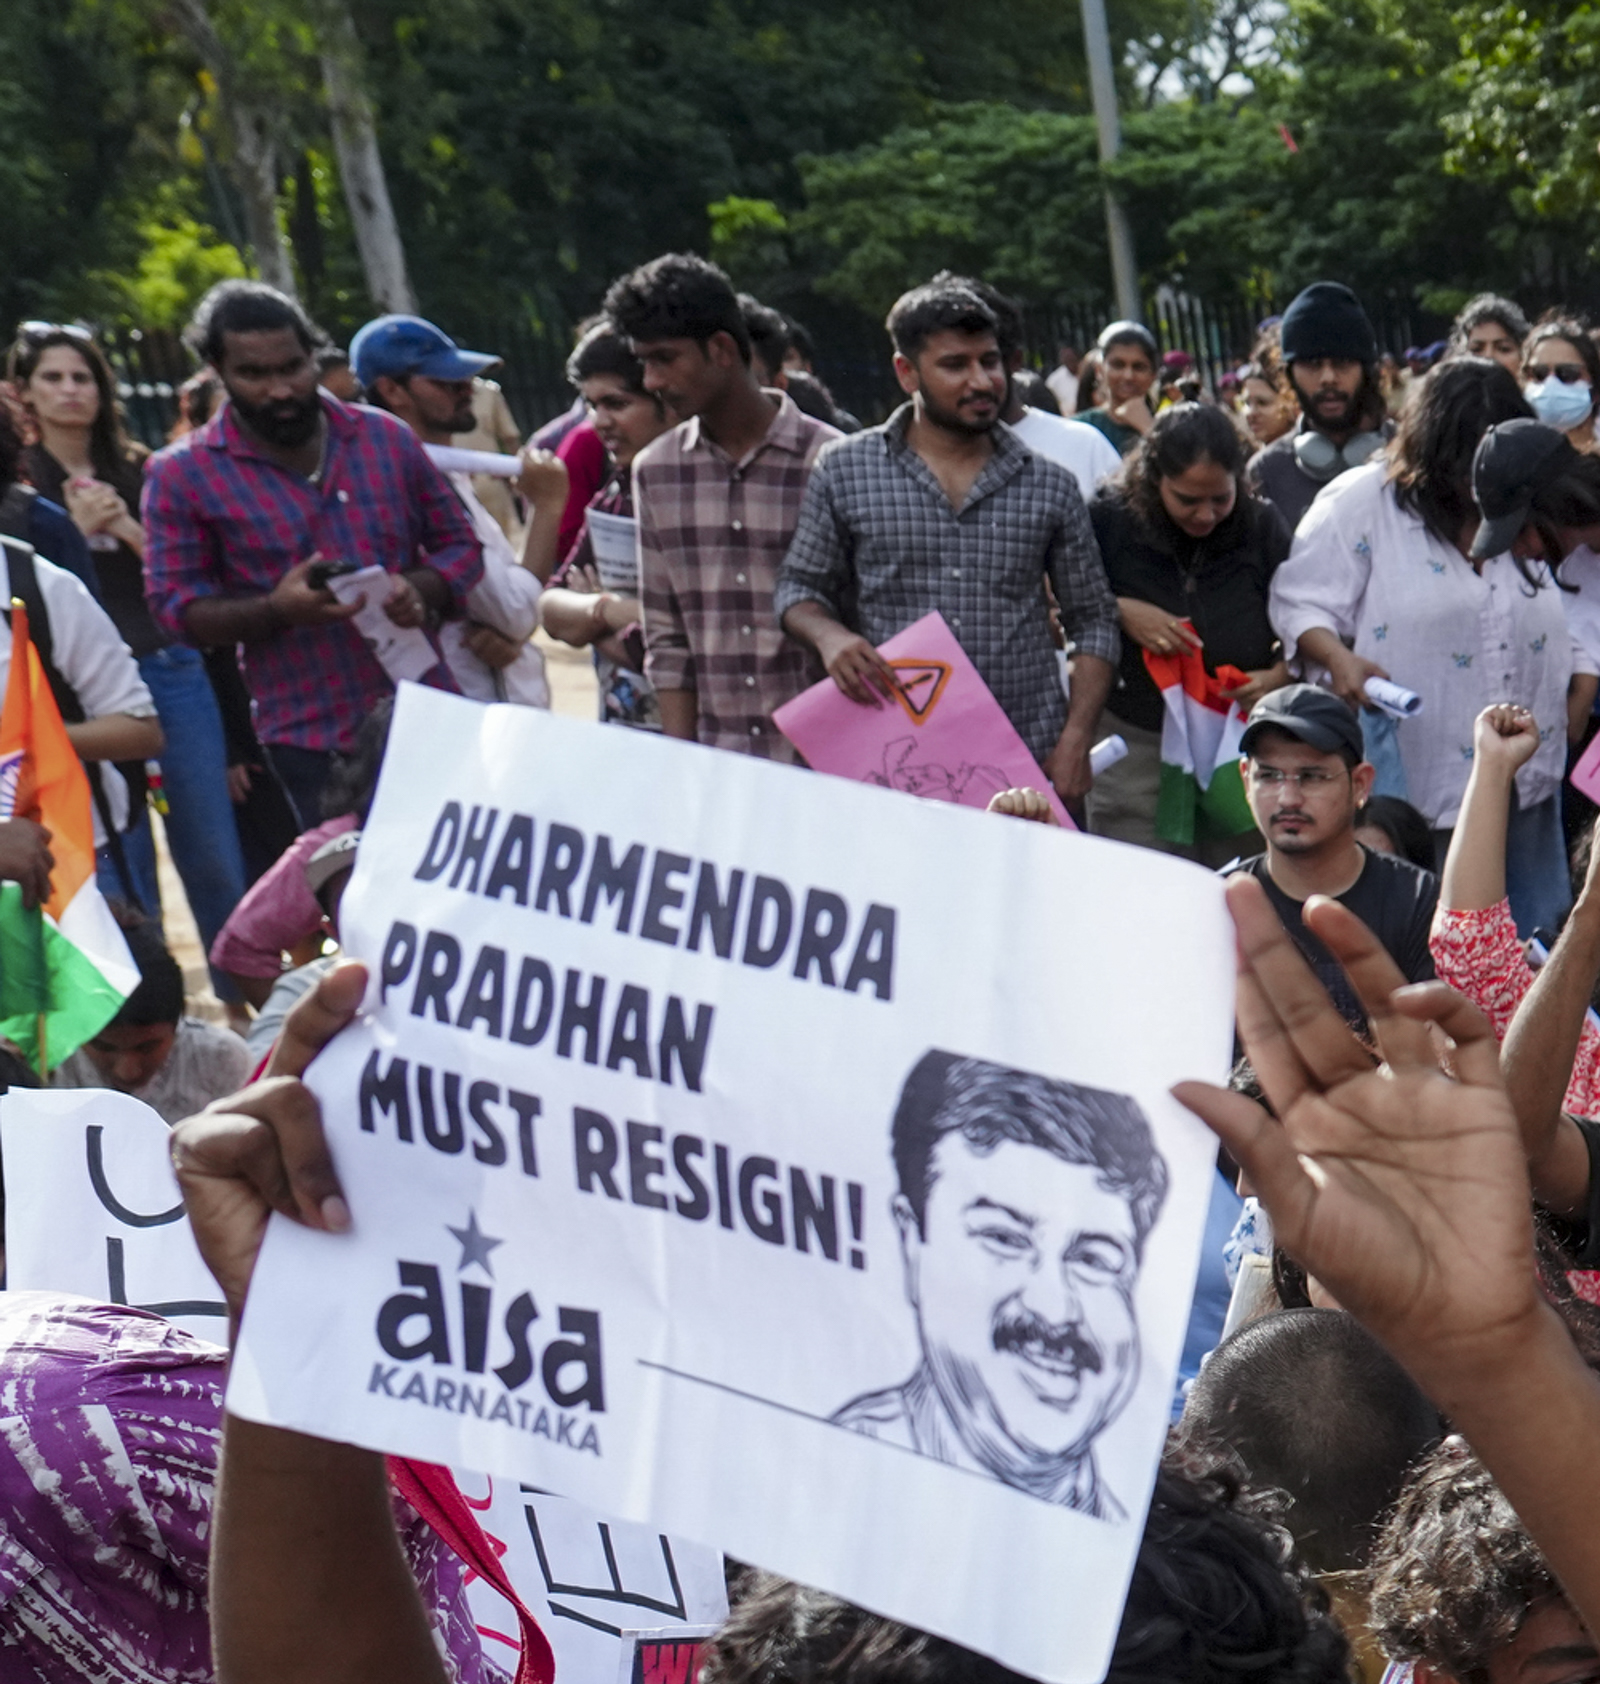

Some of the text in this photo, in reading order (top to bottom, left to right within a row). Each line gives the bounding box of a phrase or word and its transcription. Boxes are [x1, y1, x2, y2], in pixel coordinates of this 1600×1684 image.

[413, 800, 898, 1002] DHARMENDRA
[381, 920, 716, 1093] PRADHAN
[359, 1048, 543, 1179] MUST
[572, 1105, 867, 1272] RESIGN!
[366, 1361, 602, 1458] KARNATAKA
[375, 1258, 608, 1414] aisa
